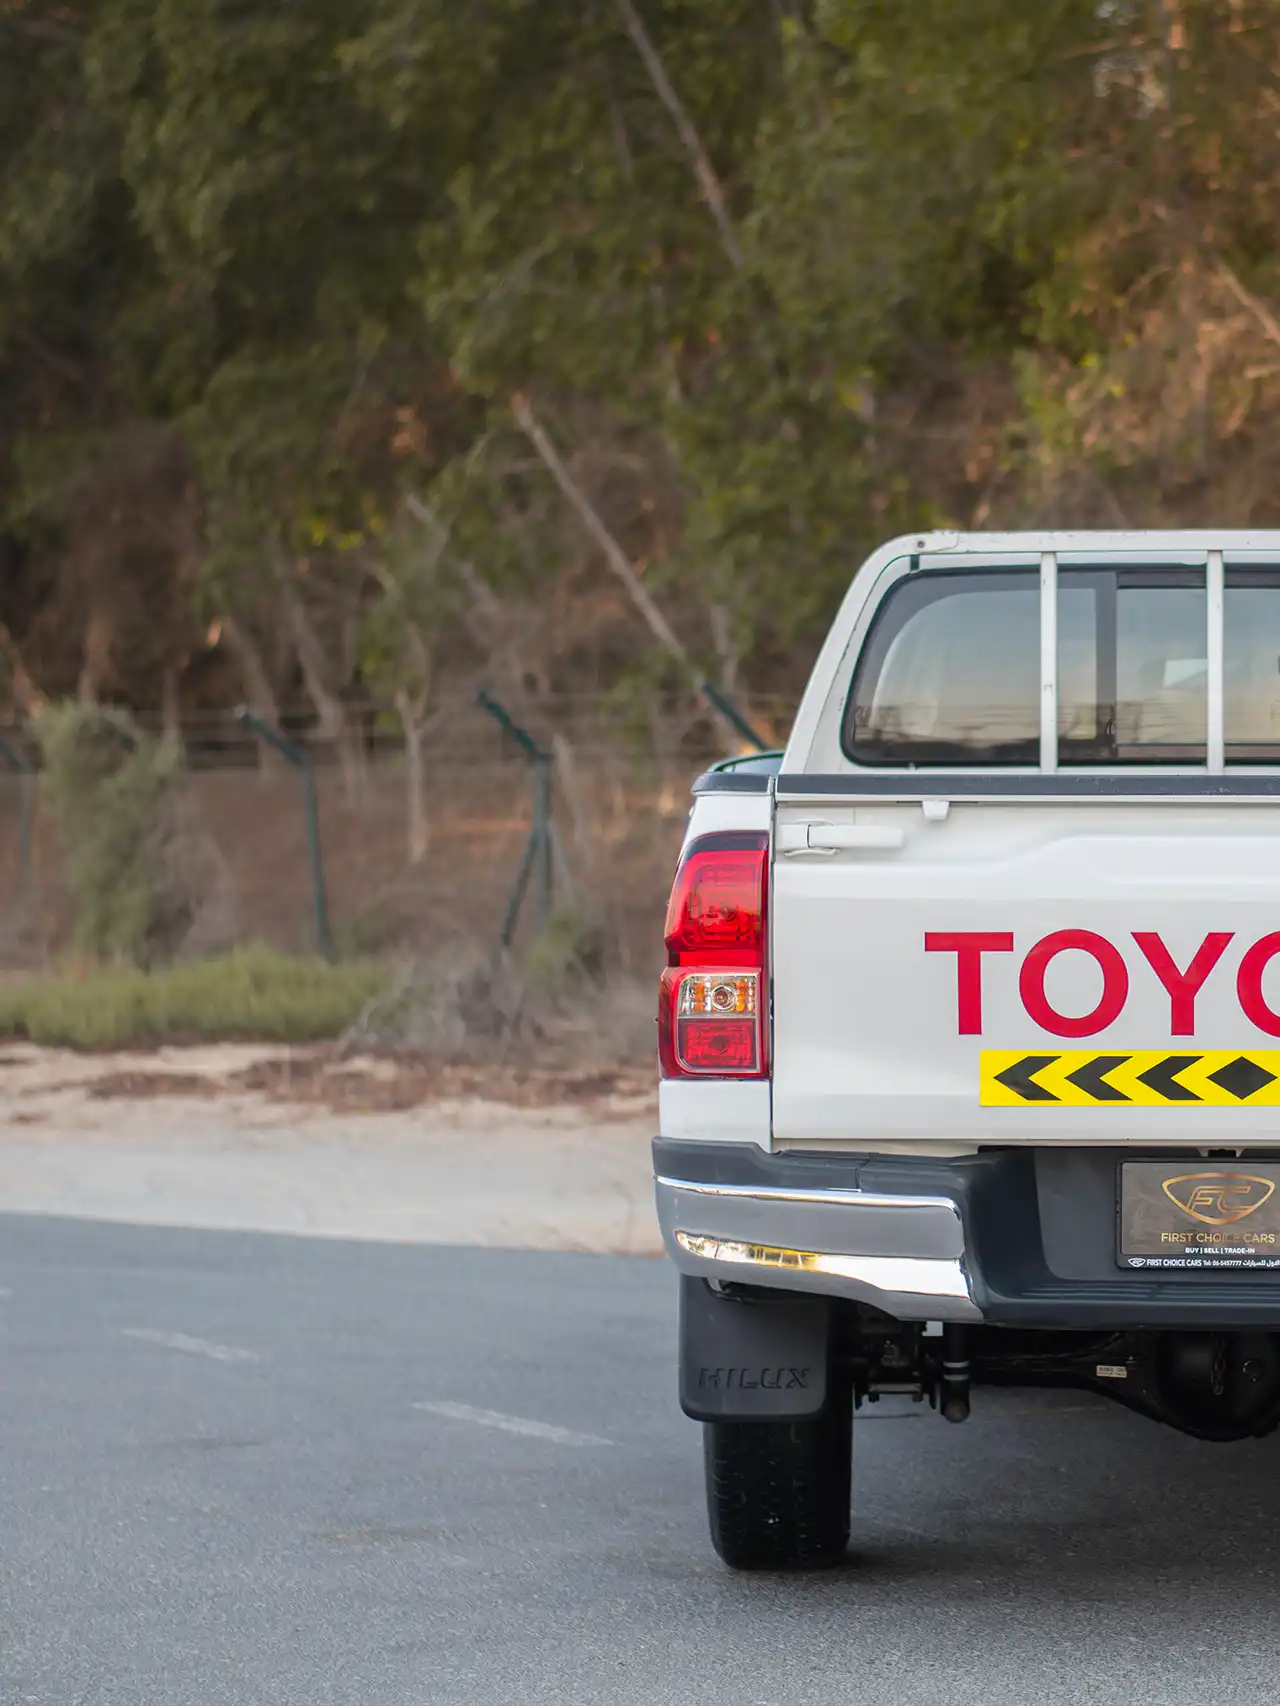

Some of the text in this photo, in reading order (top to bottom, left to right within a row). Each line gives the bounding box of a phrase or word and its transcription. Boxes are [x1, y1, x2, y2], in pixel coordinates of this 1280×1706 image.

[1161, 1232, 1275, 1243] FIRST CHOICE CARS
[698, 1367, 810, 1389] HILUX
